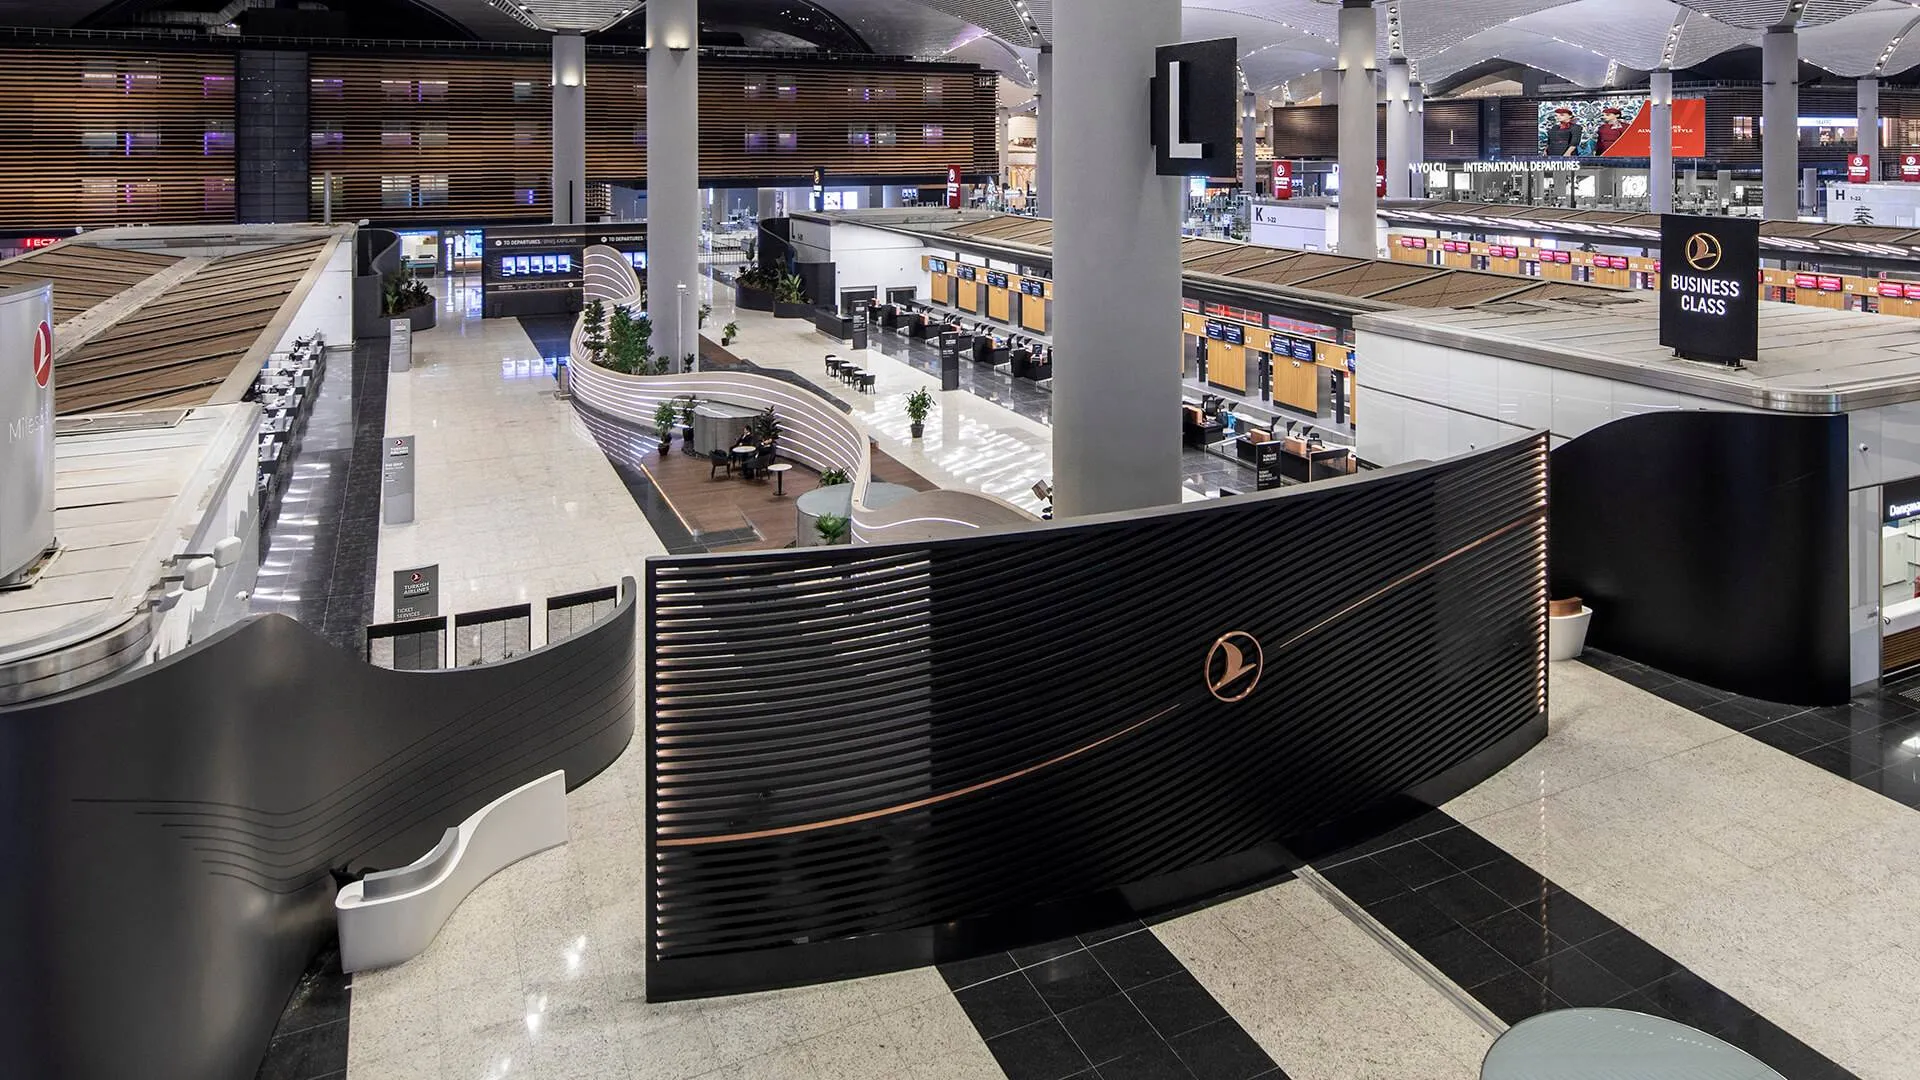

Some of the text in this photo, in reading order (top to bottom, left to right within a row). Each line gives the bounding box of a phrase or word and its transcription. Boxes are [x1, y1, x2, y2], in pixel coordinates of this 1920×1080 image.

[1169, 61, 1203, 160] L
[1418, 162, 1447, 174] YOLCU
[1463, 160, 1581, 173] INTERNATIONAL DEPARTURES
[1835, 189, 1845, 200] H
[1255, 207, 1263, 222] K
[1671, 274, 1740, 297] BUSINESS
[1681, 294, 1726, 315] CLASS
